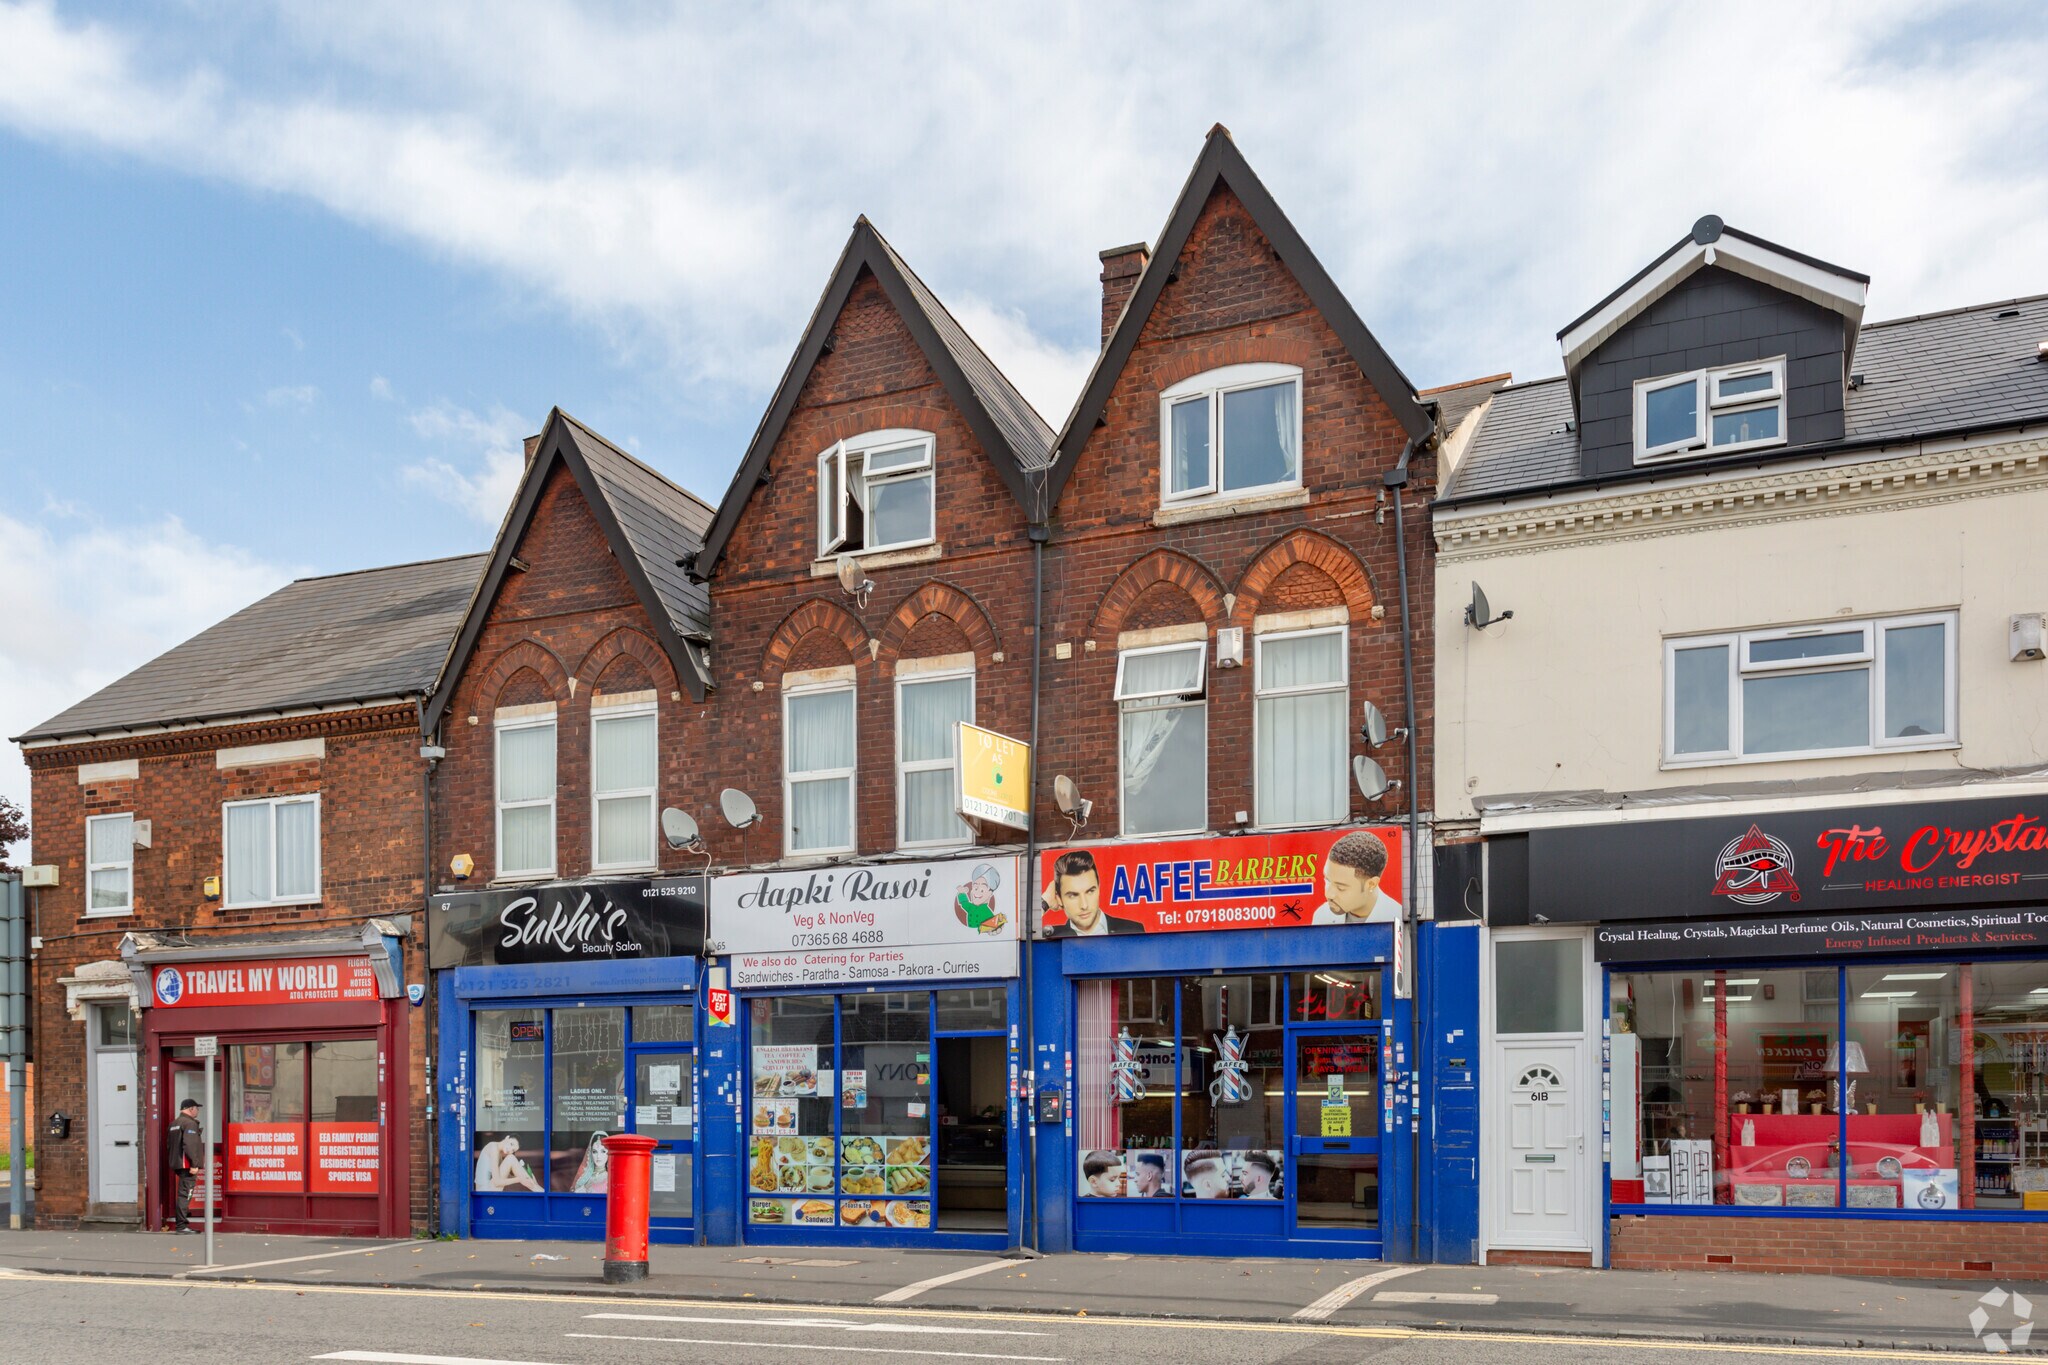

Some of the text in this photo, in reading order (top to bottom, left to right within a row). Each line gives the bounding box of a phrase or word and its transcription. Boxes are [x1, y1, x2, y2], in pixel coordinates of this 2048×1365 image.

[977, 732, 1015, 756] TO LET
[964, 798, 982, 813] 0121
[985, 804, 998, 816] 212
[1000, 808, 1017, 821] 1701
[1817, 824, 1890, 877] The
[1110, 853, 1318, 906] AAFEE BARBERS
[1865, 873, 2022, 892] HEALING ENERGIST
[642, 886, 696, 898] 0121 525 9210
[737, 868, 932, 913] Aapki Rasoi
[441, 902, 451, 911] 67
[793, 911, 875, 929] Veg & NonVeg
[1157, 906, 1276, 925] Tel: 07918083000
[500, 892, 628, 953] Sukhi's
[1599, 931, 1635, 943] Crystal
[1637, 929, 1681, 941] Healing,
[1683, 927, 1728, 939] Crystals,
[1729, 925, 1777, 937] Magickal
[1781, 923, 1828, 934] Perfume
[1831, 920, 1859, 932] Oils,
[1861, 919, 1903, 931] Natural
[1906, 916, 1969, 929] Cosmetics,
[1971, 914, 2021, 926] Spiritual
[791, 930, 884, 947] 07365 68 4688
[1825, 930, 2037, 949] Energy Infused Products & Services.
[582, 941, 642, 955] Beauty Salon
[347, 958, 373, 968] FLIGHTS
[743, 951, 904, 967] We also do Catering for Parties
[353, 968, 372, 978] VISAS
[738, 961, 980, 984] Sandwiches Paratha Samosa Pakora Curries
[186, 964, 338, 994] TRAVEL MY WORLD
[350, 978, 372, 988] HOTELS
[501, 978, 529, 990] 525
[290, 990, 338, 1000] ATOL PROTECTED
[343, 988, 372, 998] HOLIDAYS
[712, 992, 727, 1003] JUST
[715, 1002, 727, 1012] EAT
[512, 1026, 542, 1038] OPEN
[1112, 1061, 1140, 1070] AAFEE
[1217, 1061, 1245, 1070] AAFEE
[1804, 1061, 1821, 1070] NO
[239, 1133, 295, 1143] BIOMETRIC CARDS
[319, 1133, 331, 1142] EEA
[332, 1133, 355, 1142] FAMILY
[236, 1145, 253, 1156] INDIA
[253, 1145, 273, 1155] VISAS
[273, 1145, 286, 1155] AND
[319, 1145, 328, 1156] EU
[249, 1158, 285, 1168] PASSPORTS
[320, 1158, 379, 1169] RESIDENCE CARDS
[242, 1171, 255, 1181] USA
[256, 1172, 261, 1180] &
[261, 1171, 287, 1181] CANADA
[287, 1171, 303, 1181] VISA
[328, 1172, 372, 1182] SPOUSE VISA
[752, 1200, 772, 1208] Burger
[804, 1215, 834, 1224] Sandwich
